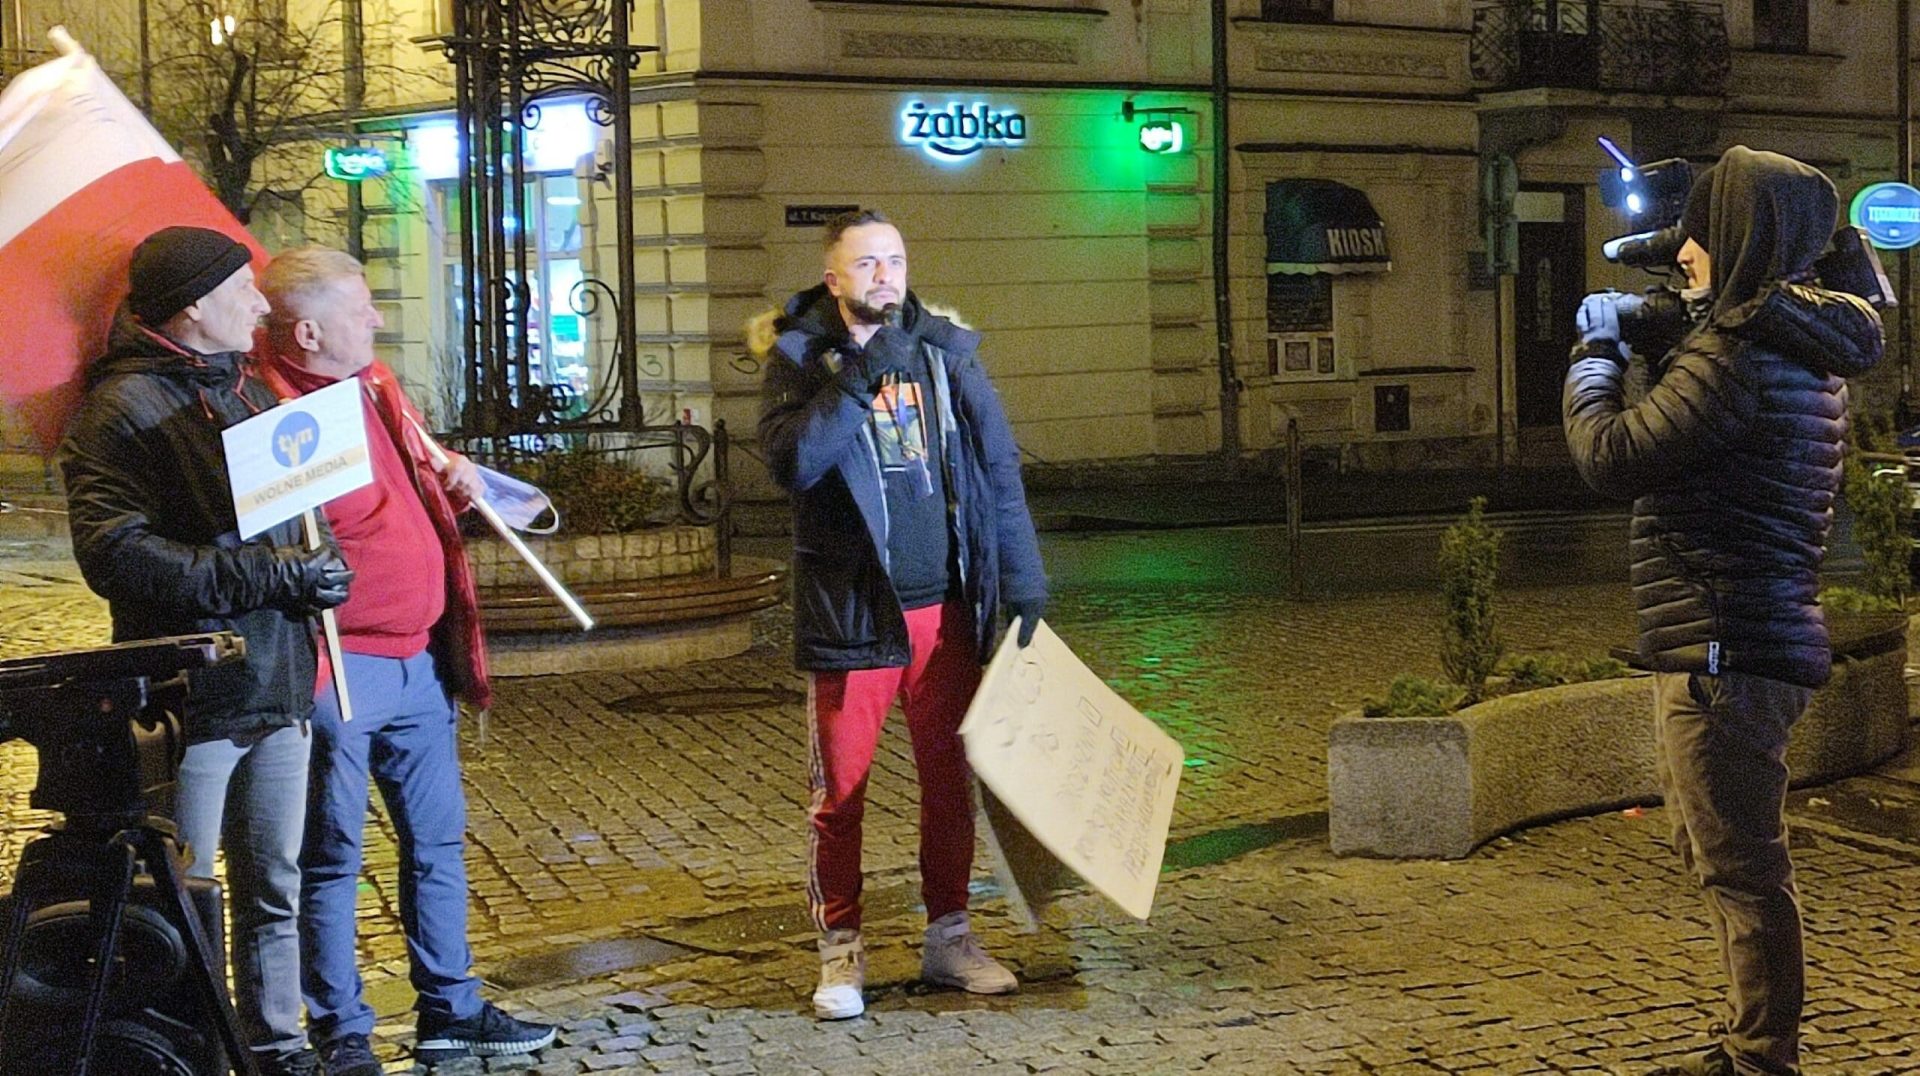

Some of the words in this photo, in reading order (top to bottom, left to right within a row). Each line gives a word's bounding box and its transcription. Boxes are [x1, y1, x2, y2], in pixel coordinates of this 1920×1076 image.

[907, 102, 1026, 139] żabka
[1326, 228, 1386, 257] KIOSK
[253, 475, 303, 505] WOLNE
[304, 456, 348, 483] MEDIA
